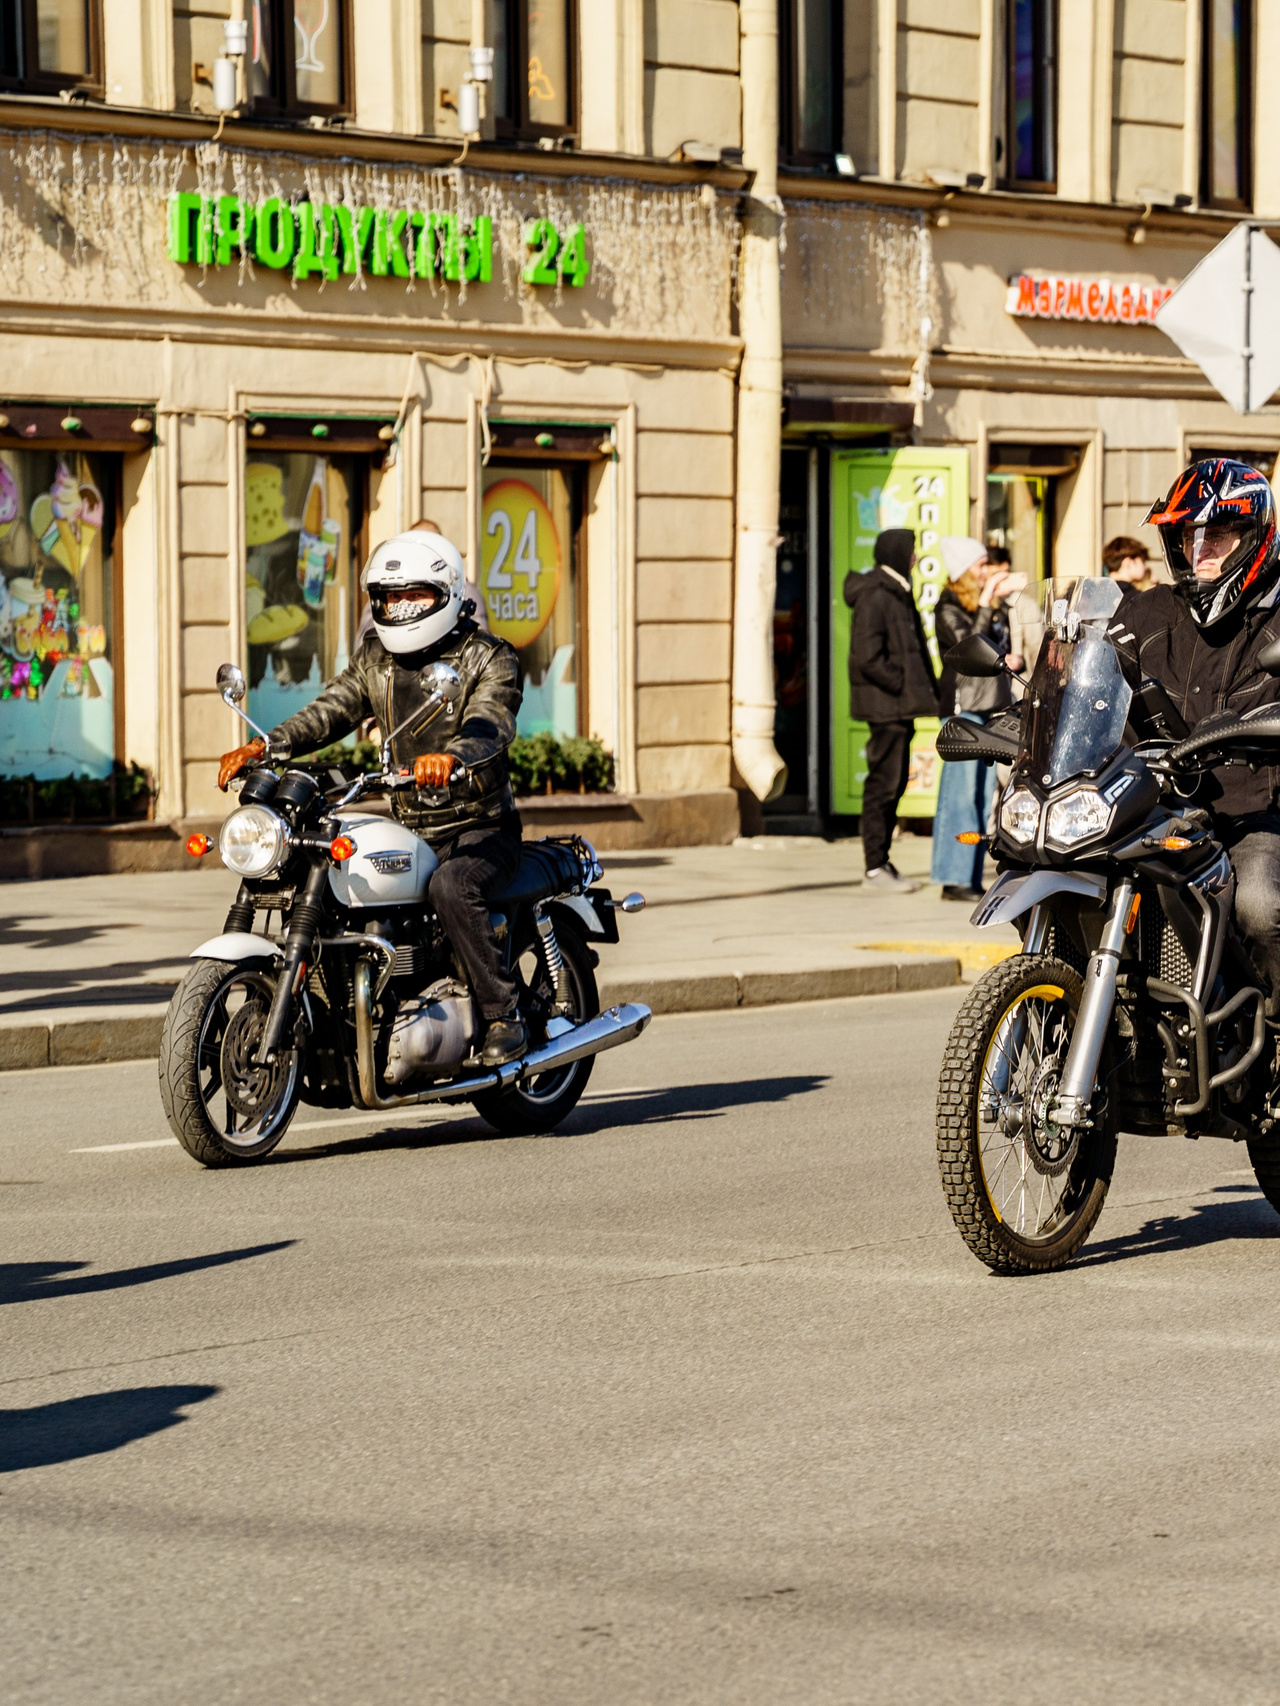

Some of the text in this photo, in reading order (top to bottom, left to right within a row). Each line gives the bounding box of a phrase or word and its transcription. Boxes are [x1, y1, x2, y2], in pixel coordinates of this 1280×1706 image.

[167, 192, 589, 287] ПРОДУКТЫ 24
[914, 477, 944, 498] 24
[487, 509, 541, 589] 24
[489, 592, 539, 619] часа
